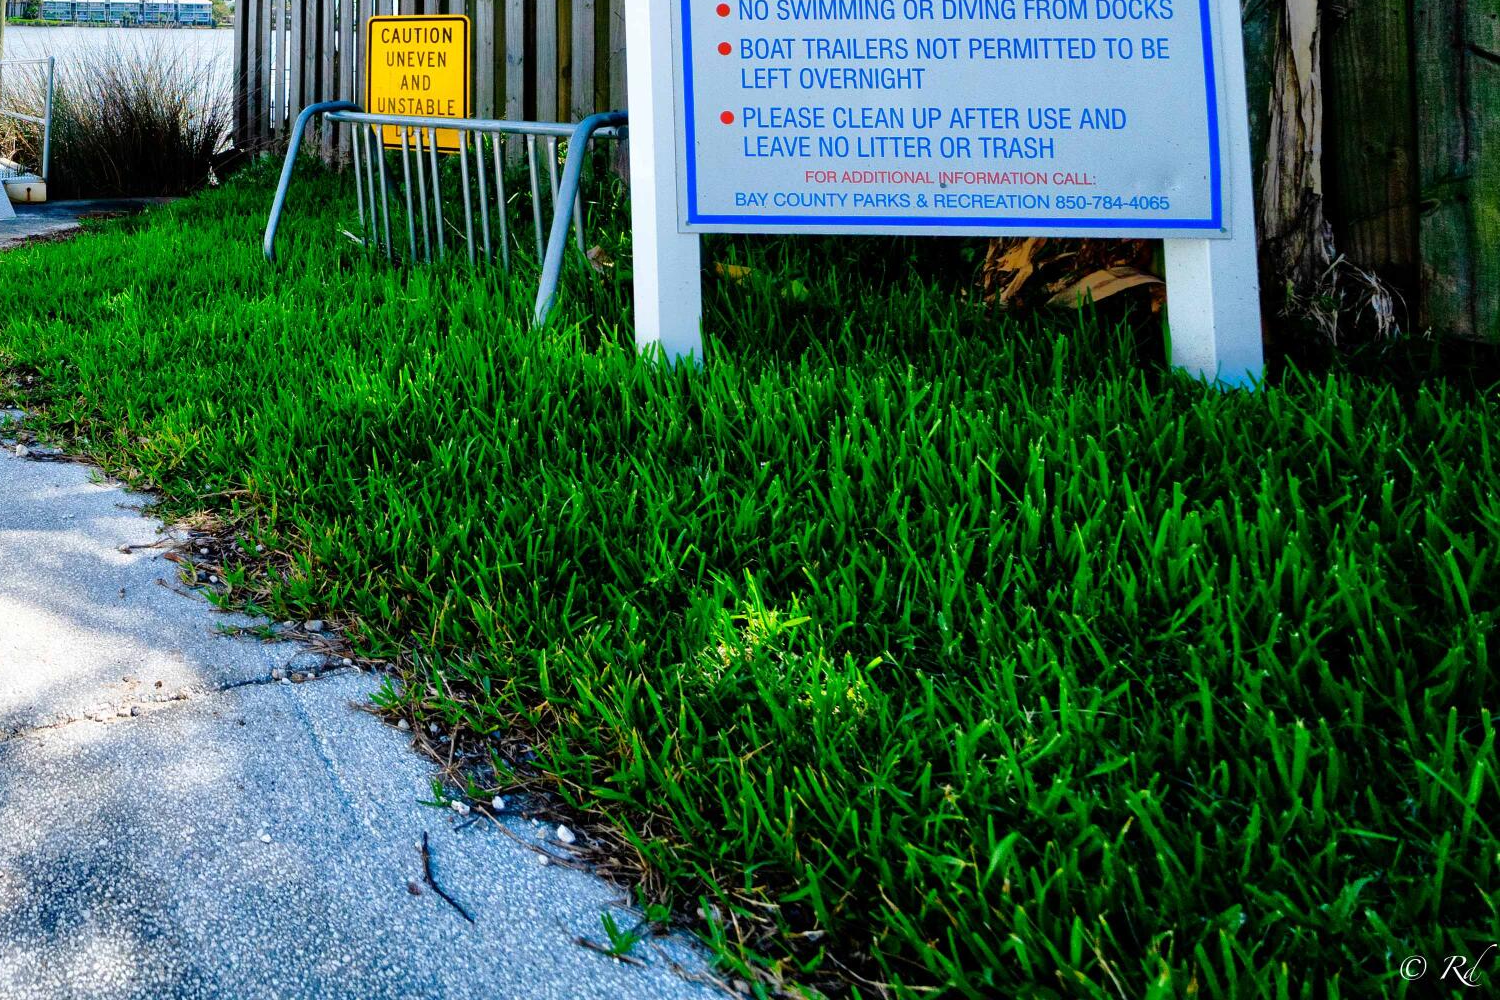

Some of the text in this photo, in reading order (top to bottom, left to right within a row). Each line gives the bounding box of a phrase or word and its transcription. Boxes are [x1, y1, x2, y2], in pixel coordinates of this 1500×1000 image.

[739, 0, 768, 20] NO
[777, 0, 895, 20] SWIMMING
[904, 0, 934, 20] OR
[943, 0, 1015, 19] DIVING
[381, 27, 453, 44] CAUTION
[740, 38, 1169, 59] BOAT TRAILERS NOT PERMITTED TO BE
[386, 51, 446, 68] UNEVEN
[400, 74, 431, 91] AND
[742, 68, 925, 89] LEFT OVERNIGHT
[377, 97, 456, 116] UNSTABLE
[743, 107, 1126, 129] PLEASE CLEAN UP AFTER USE AND
[744, 136, 1054, 159] LEAVE NO LITTER OR TRASH
[805, 170, 1096, 186] FOR ADDITIONAL INFORMATION CALL:
[736, 193, 1170, 210] BAY COUNTY PARKS & RECREATION 850-784-4065
